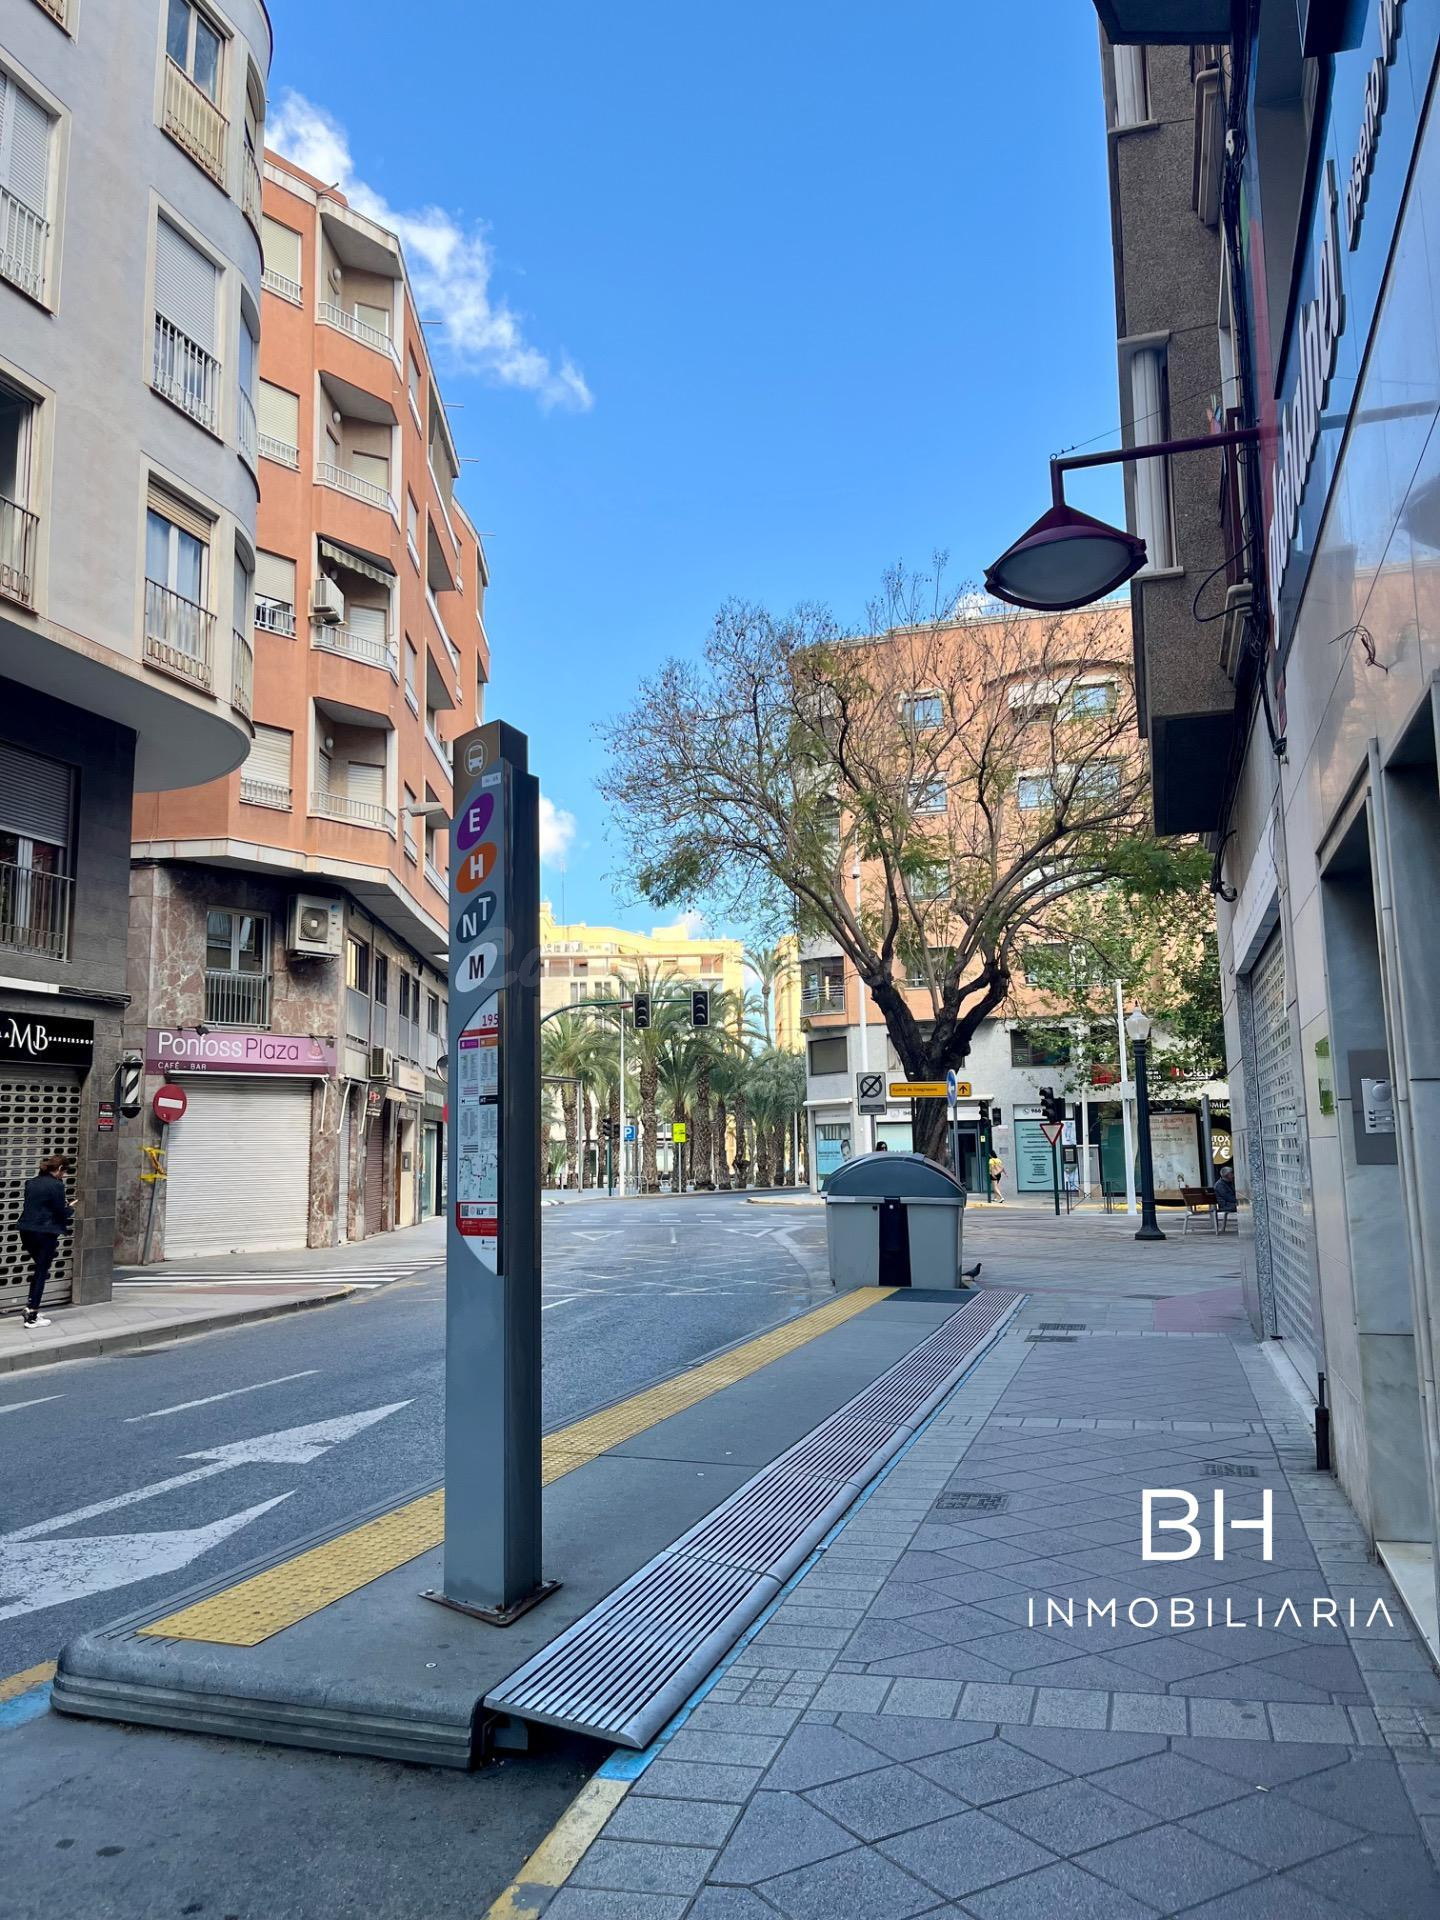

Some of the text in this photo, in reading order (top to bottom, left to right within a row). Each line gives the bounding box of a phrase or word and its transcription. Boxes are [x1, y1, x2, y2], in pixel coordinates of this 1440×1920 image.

[469, 808, 480, 832] E
[470, 854, 484, 880] H
[469, 954, 484, 980] M
[8, 1018, 48, 1055] MB
[158, 1032, 299, 1060] Ponfoss Plaza
[158, 1061, 180, 1070] CAFÉ
